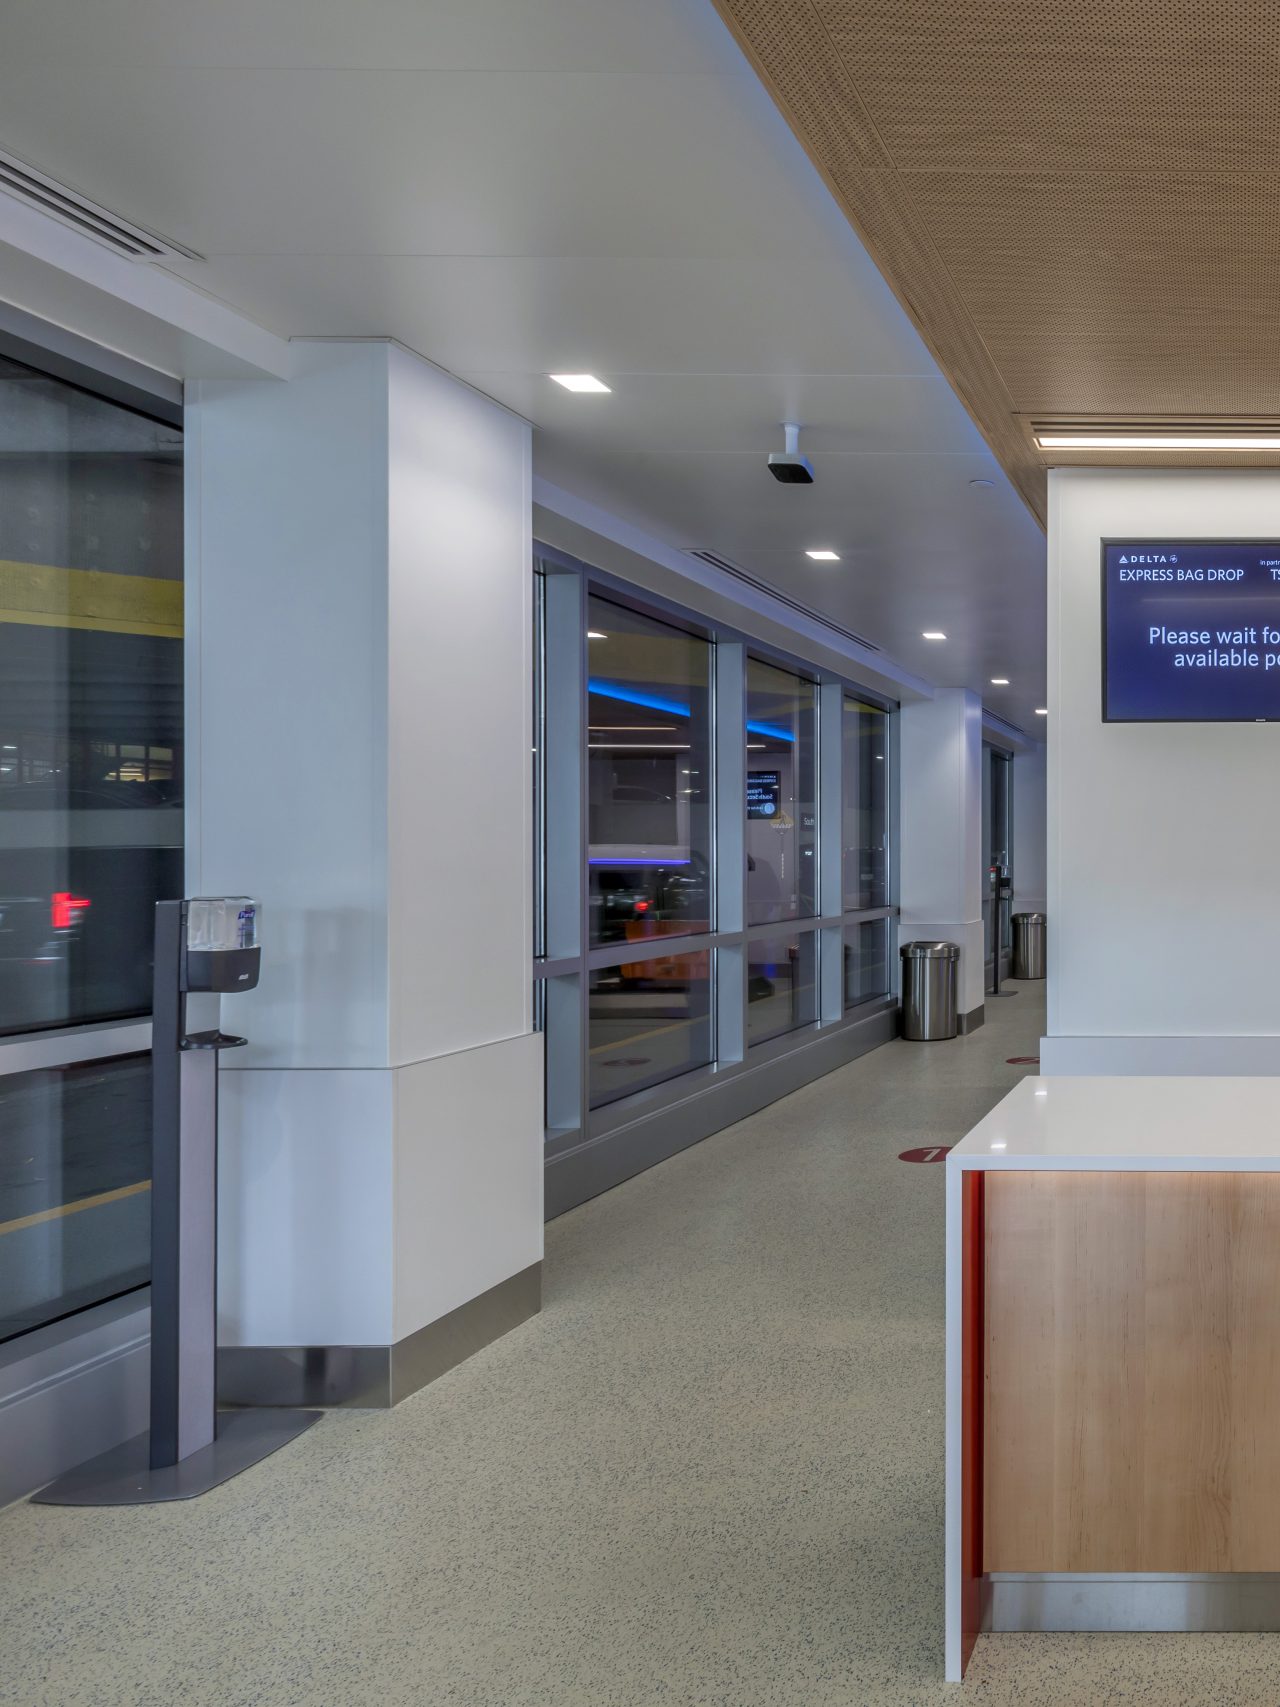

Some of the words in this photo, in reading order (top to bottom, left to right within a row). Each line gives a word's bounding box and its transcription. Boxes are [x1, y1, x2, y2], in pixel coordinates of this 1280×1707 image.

[1131, 555, 1167, 563] DELTA
[1119, 569, 1174, 581] EXPRESS
[1177, 569, 1204, 581] BAG
[1207, 569, 1244, 581] DROP
[1149, 627, 1211, 644] Please
[1217, 627, 1257, 644] wait
[1174, 649, 1259, 666] available
